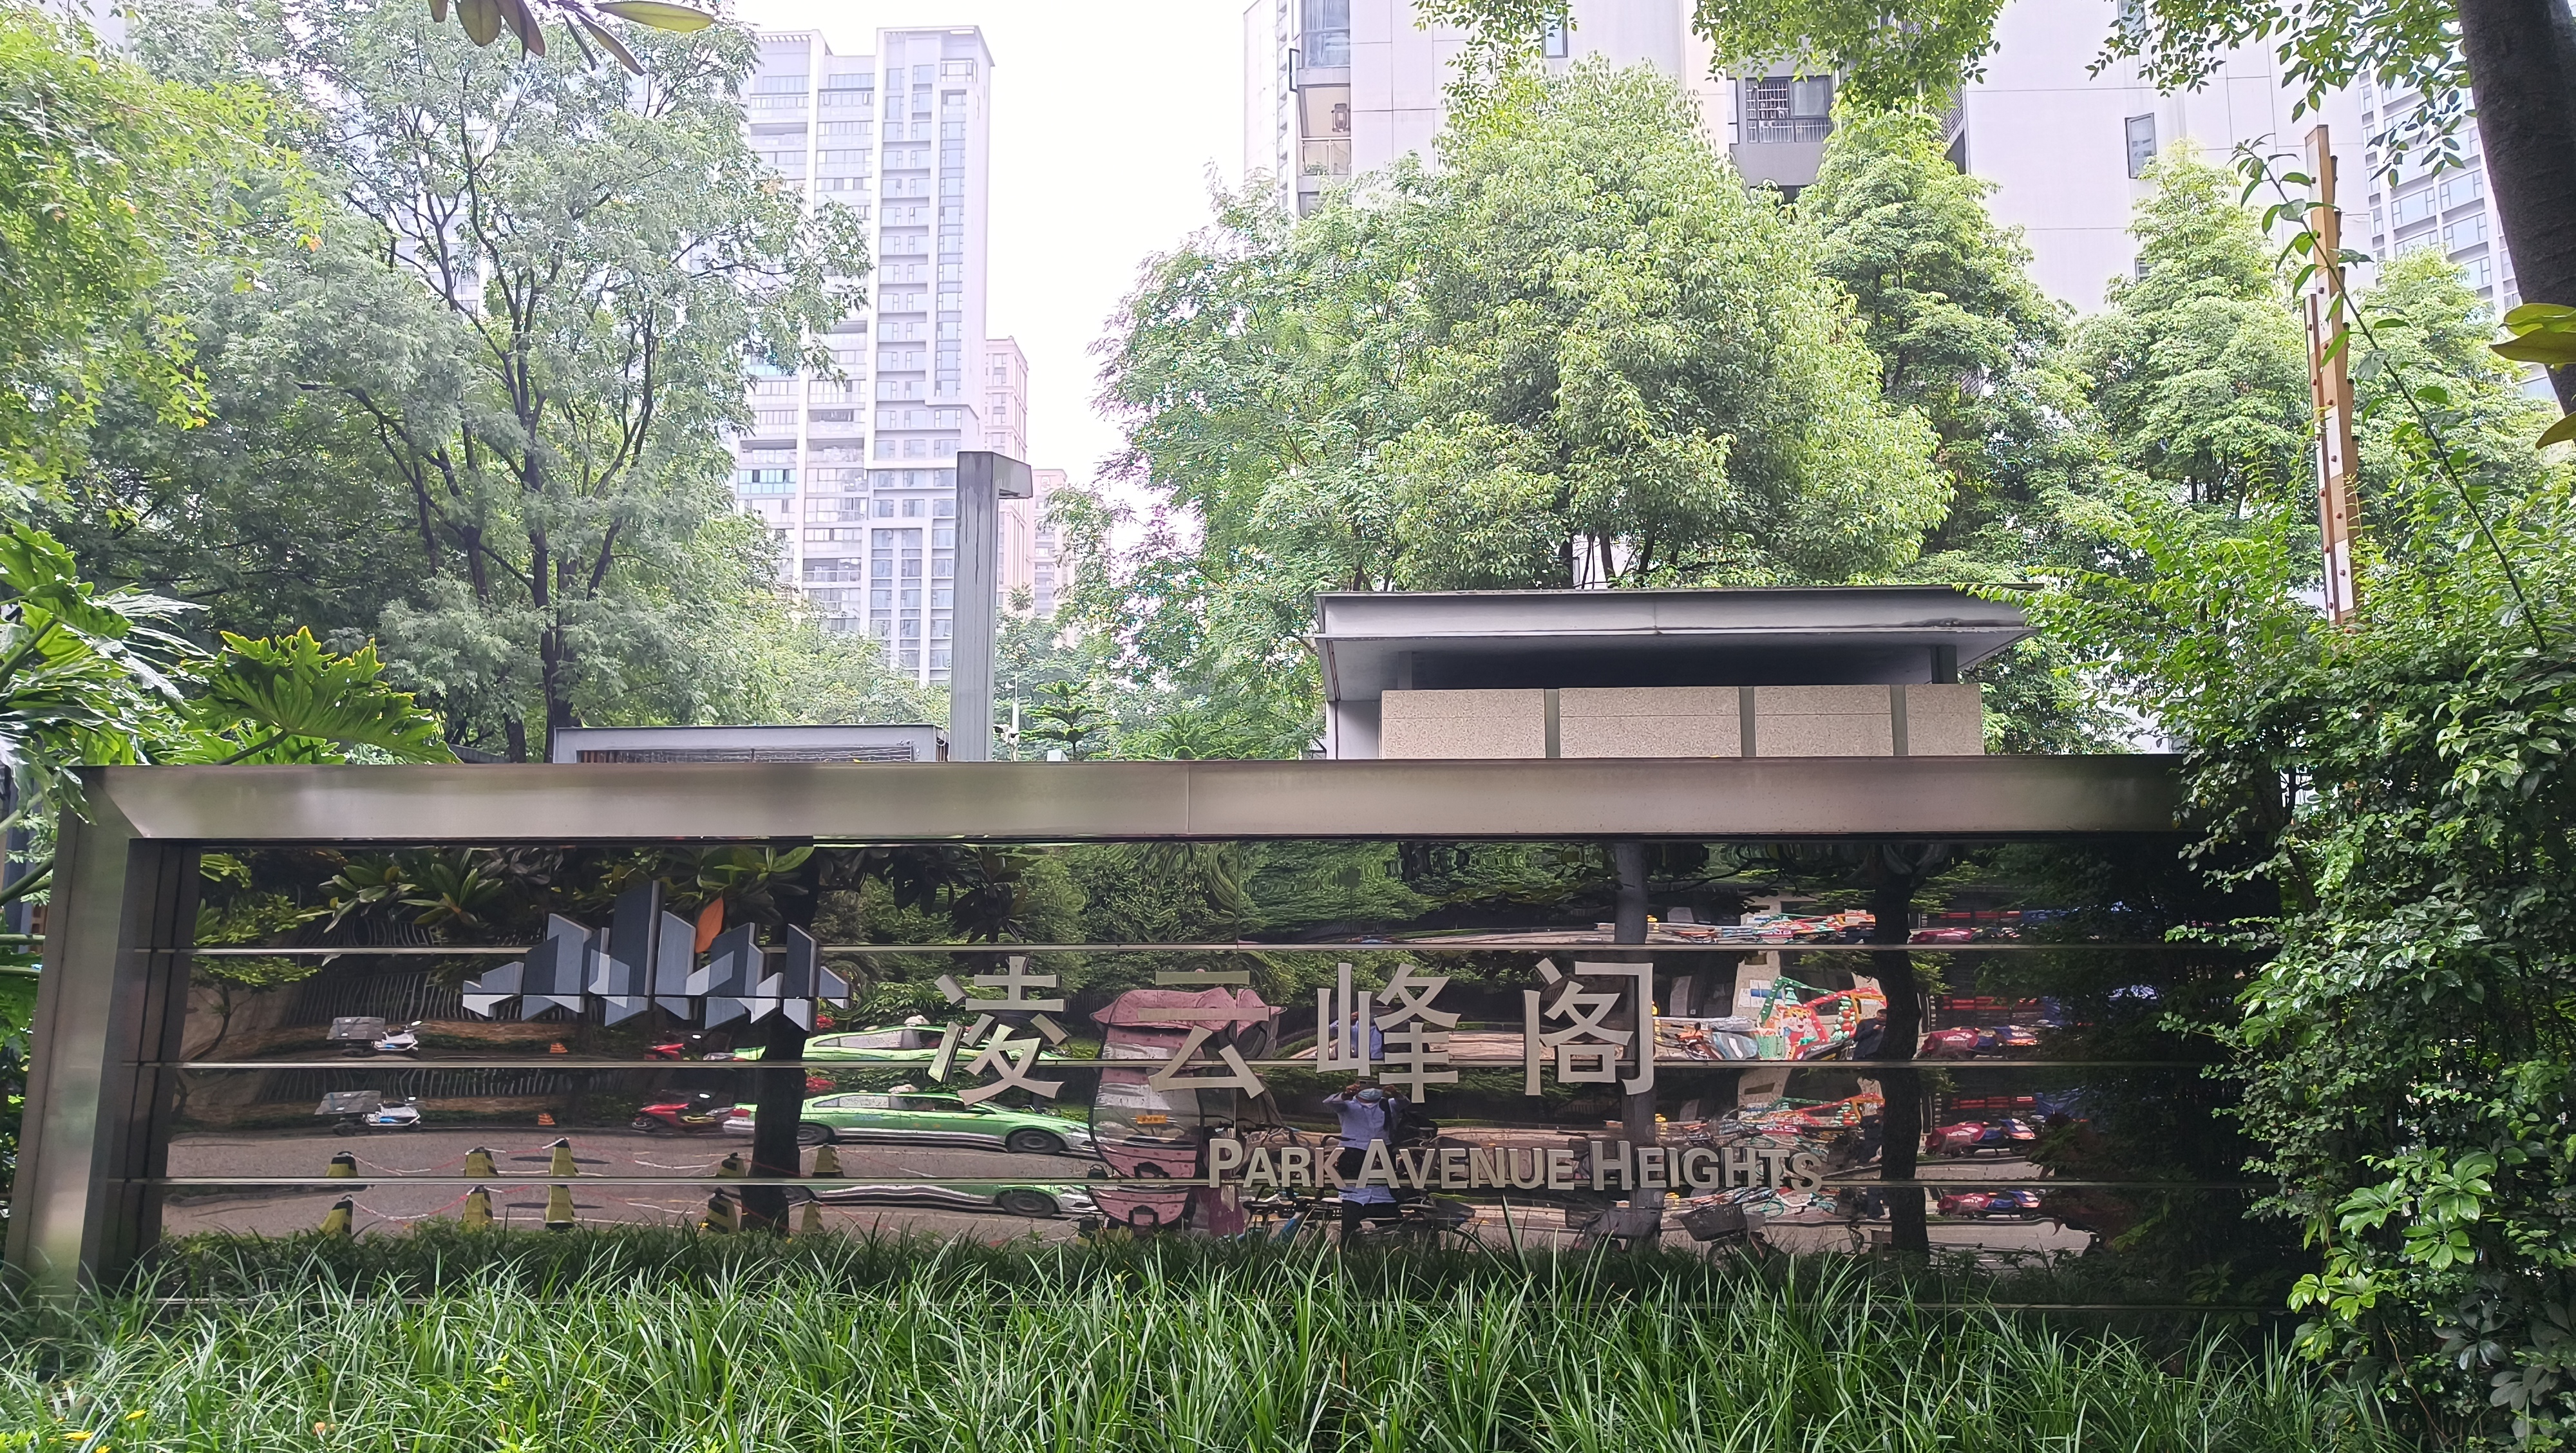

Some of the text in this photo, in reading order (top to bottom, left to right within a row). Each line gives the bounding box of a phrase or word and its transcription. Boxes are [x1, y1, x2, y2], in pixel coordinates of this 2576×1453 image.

[928, 956, 1654, 1105] 凌云峰阁
[1209, 1138, 1822, 1193] PARK AVENUE HEIGHTS
